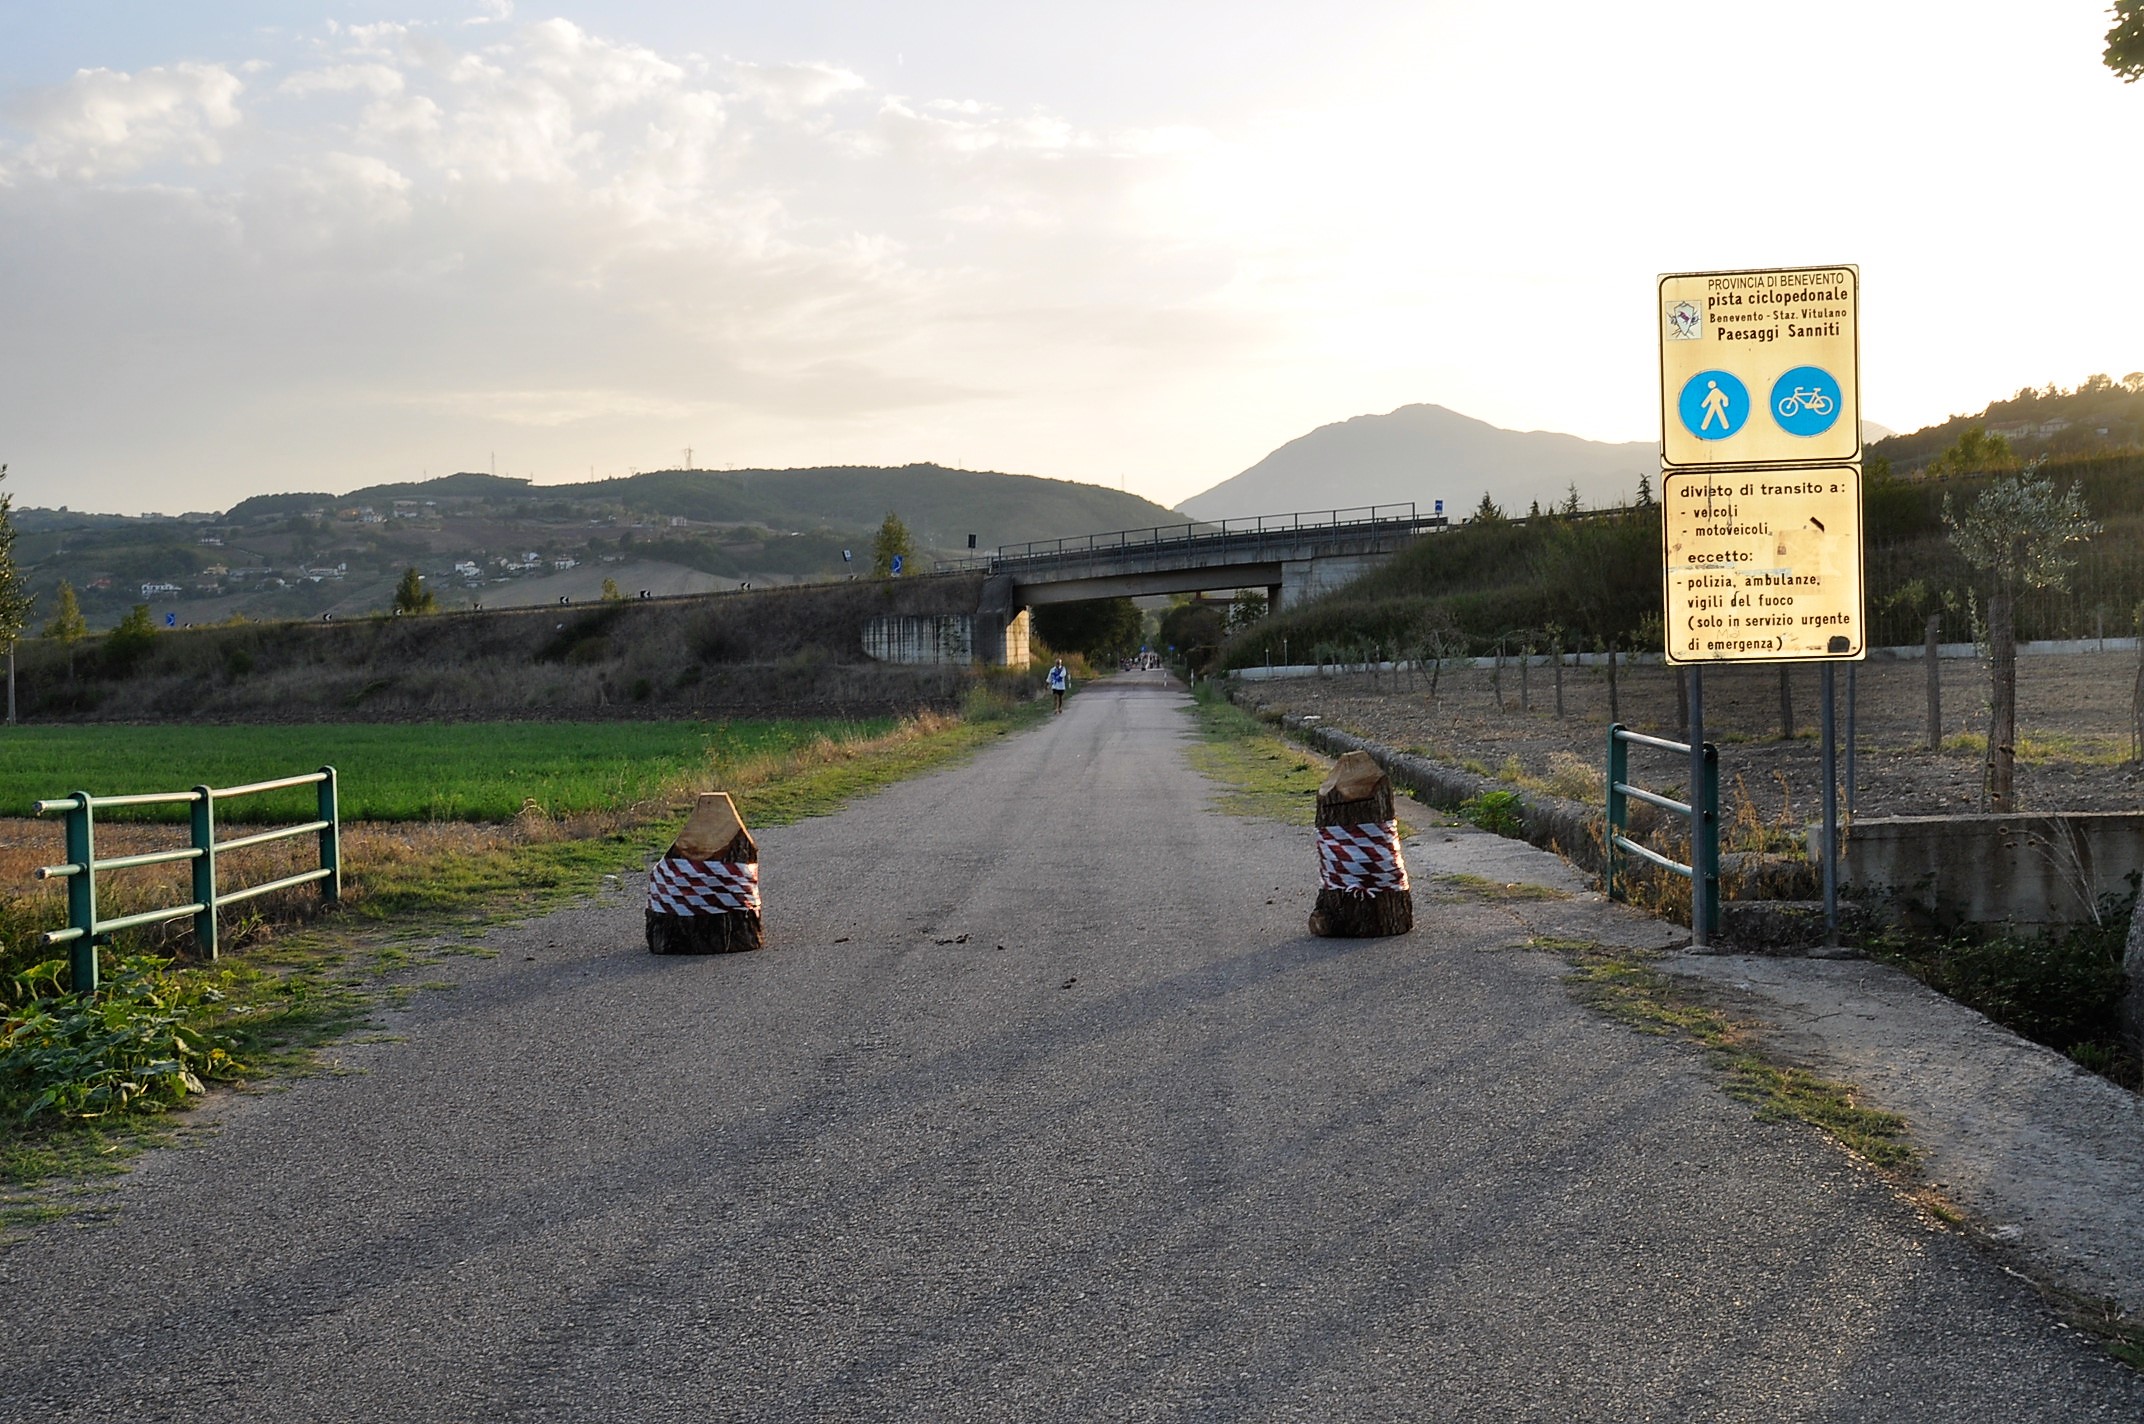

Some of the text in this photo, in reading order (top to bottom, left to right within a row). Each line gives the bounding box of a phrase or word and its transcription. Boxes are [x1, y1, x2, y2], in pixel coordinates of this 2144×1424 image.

[1709, 273, 1844, 291] PROVINCIA DI BENEVENTO
[1709, 287, 1847, 309] pista ciclopedonale
[1710, 313, 1763, 323] Benevento
[1773, 311, 1798, 320] Staz.
[1802, 308, 1847, 318] Vitulano
[1718, 323, 1840, 342] Paesaggi Sanniti
[1681, 483, 1845, 497] divieto di transito a:
[1694, 505, 1738, 518] veicoli
[1696, 523, 1769, 536] motoveicoli
[1688, 551, 1753, 563] eccetto:
[1688, 595, 1722, 610] vigili
[1759, 594, 1793, 606] fuoco
[1688, 612, 1850, 630] (solo in servizio urgente
[1688, 637, 1783, 652] di emergenza)
